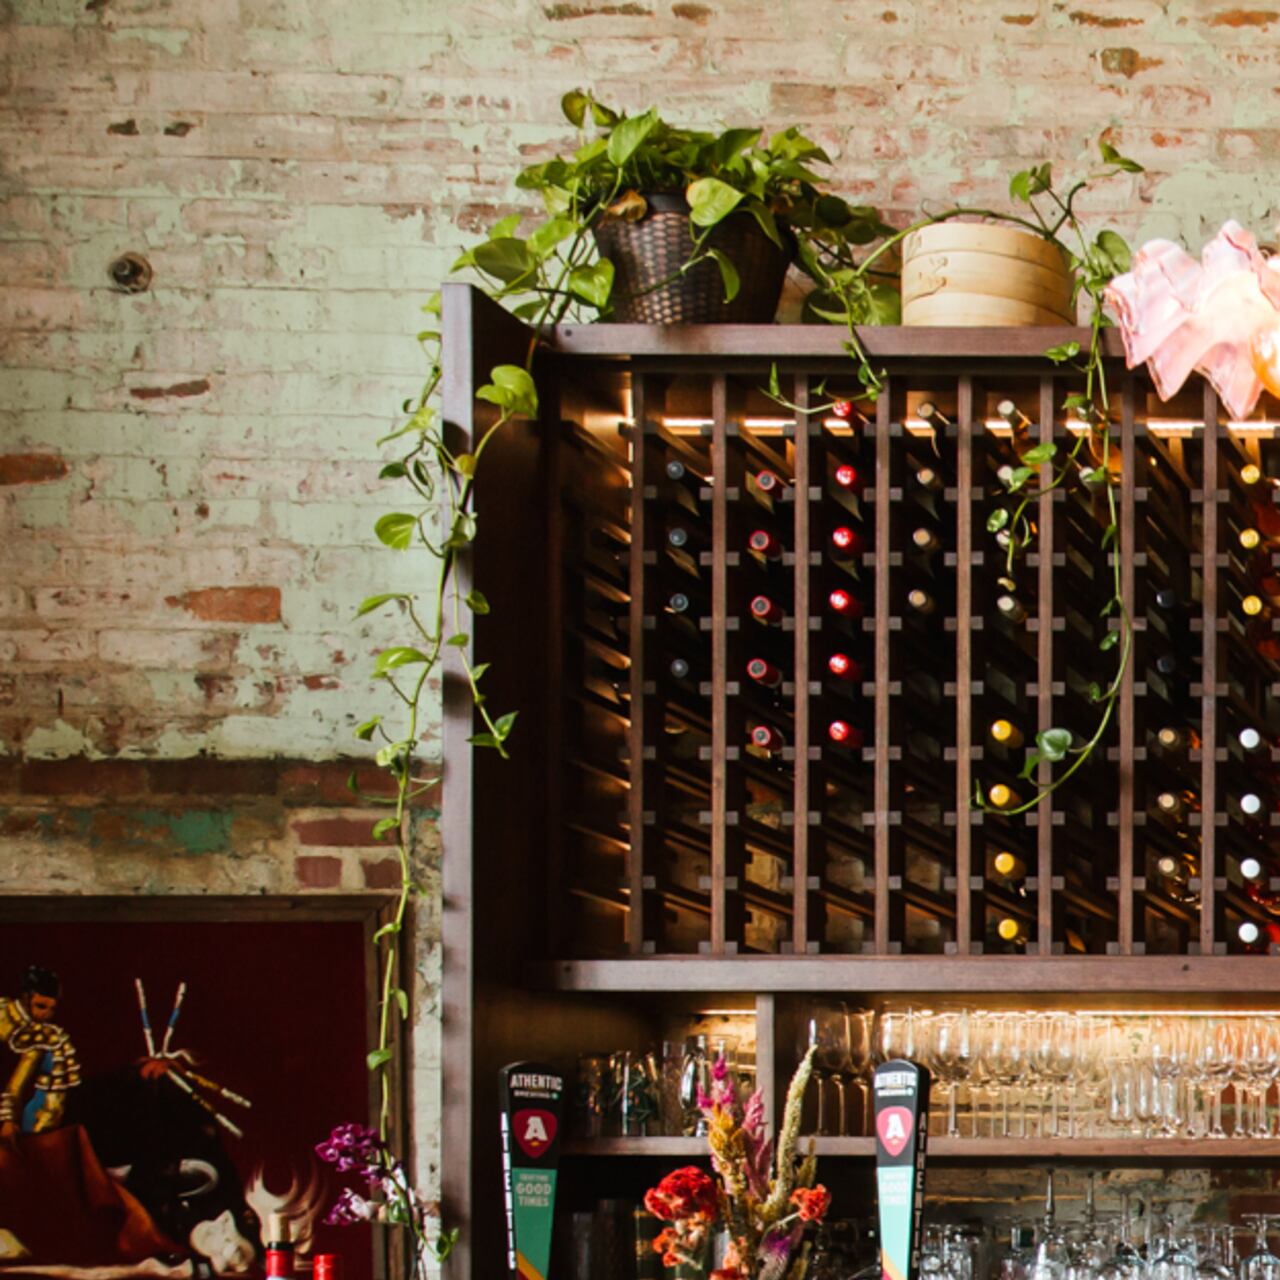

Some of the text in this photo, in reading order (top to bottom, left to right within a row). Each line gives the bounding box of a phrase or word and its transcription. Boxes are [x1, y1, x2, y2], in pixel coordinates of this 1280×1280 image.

[510, 1073, 562, 1091] ATHENTIC
[516, 1182, 552, 1195] GOOD
[518, 1196, 549, 1207] TIMES
